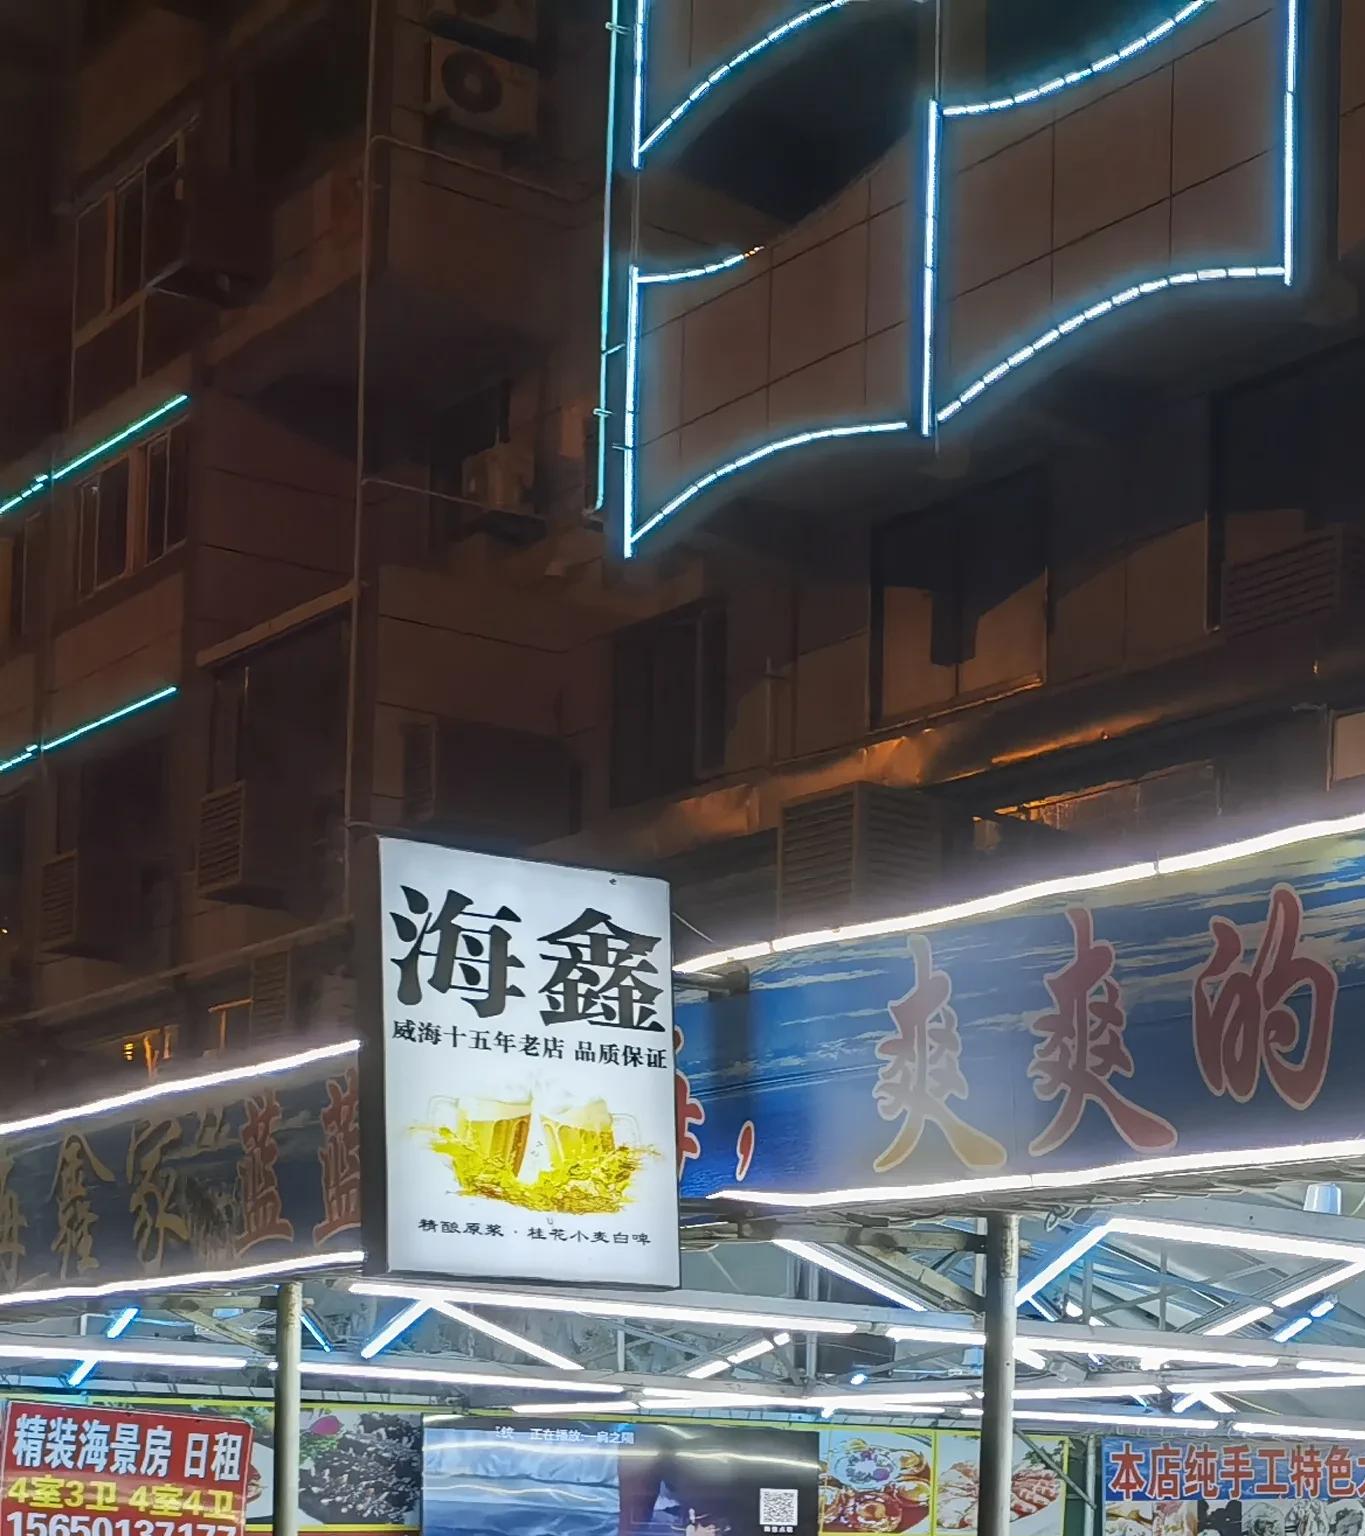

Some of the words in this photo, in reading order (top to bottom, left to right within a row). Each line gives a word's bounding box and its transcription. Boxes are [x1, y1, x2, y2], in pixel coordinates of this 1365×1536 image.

[388, 885, 666, 1034] 海鑫
[392, 1019, 566, 1061] 威海十五年老店
[574, 1040, 668, 1070] 品质保证
[12, 1412, 174, 1478] 精装海景房
[184, 1431, 244, 1482] 日租
[8, 1474, 120, 1513] 4室3卫
[128, 1482, 238, 1521] 4室4卫
